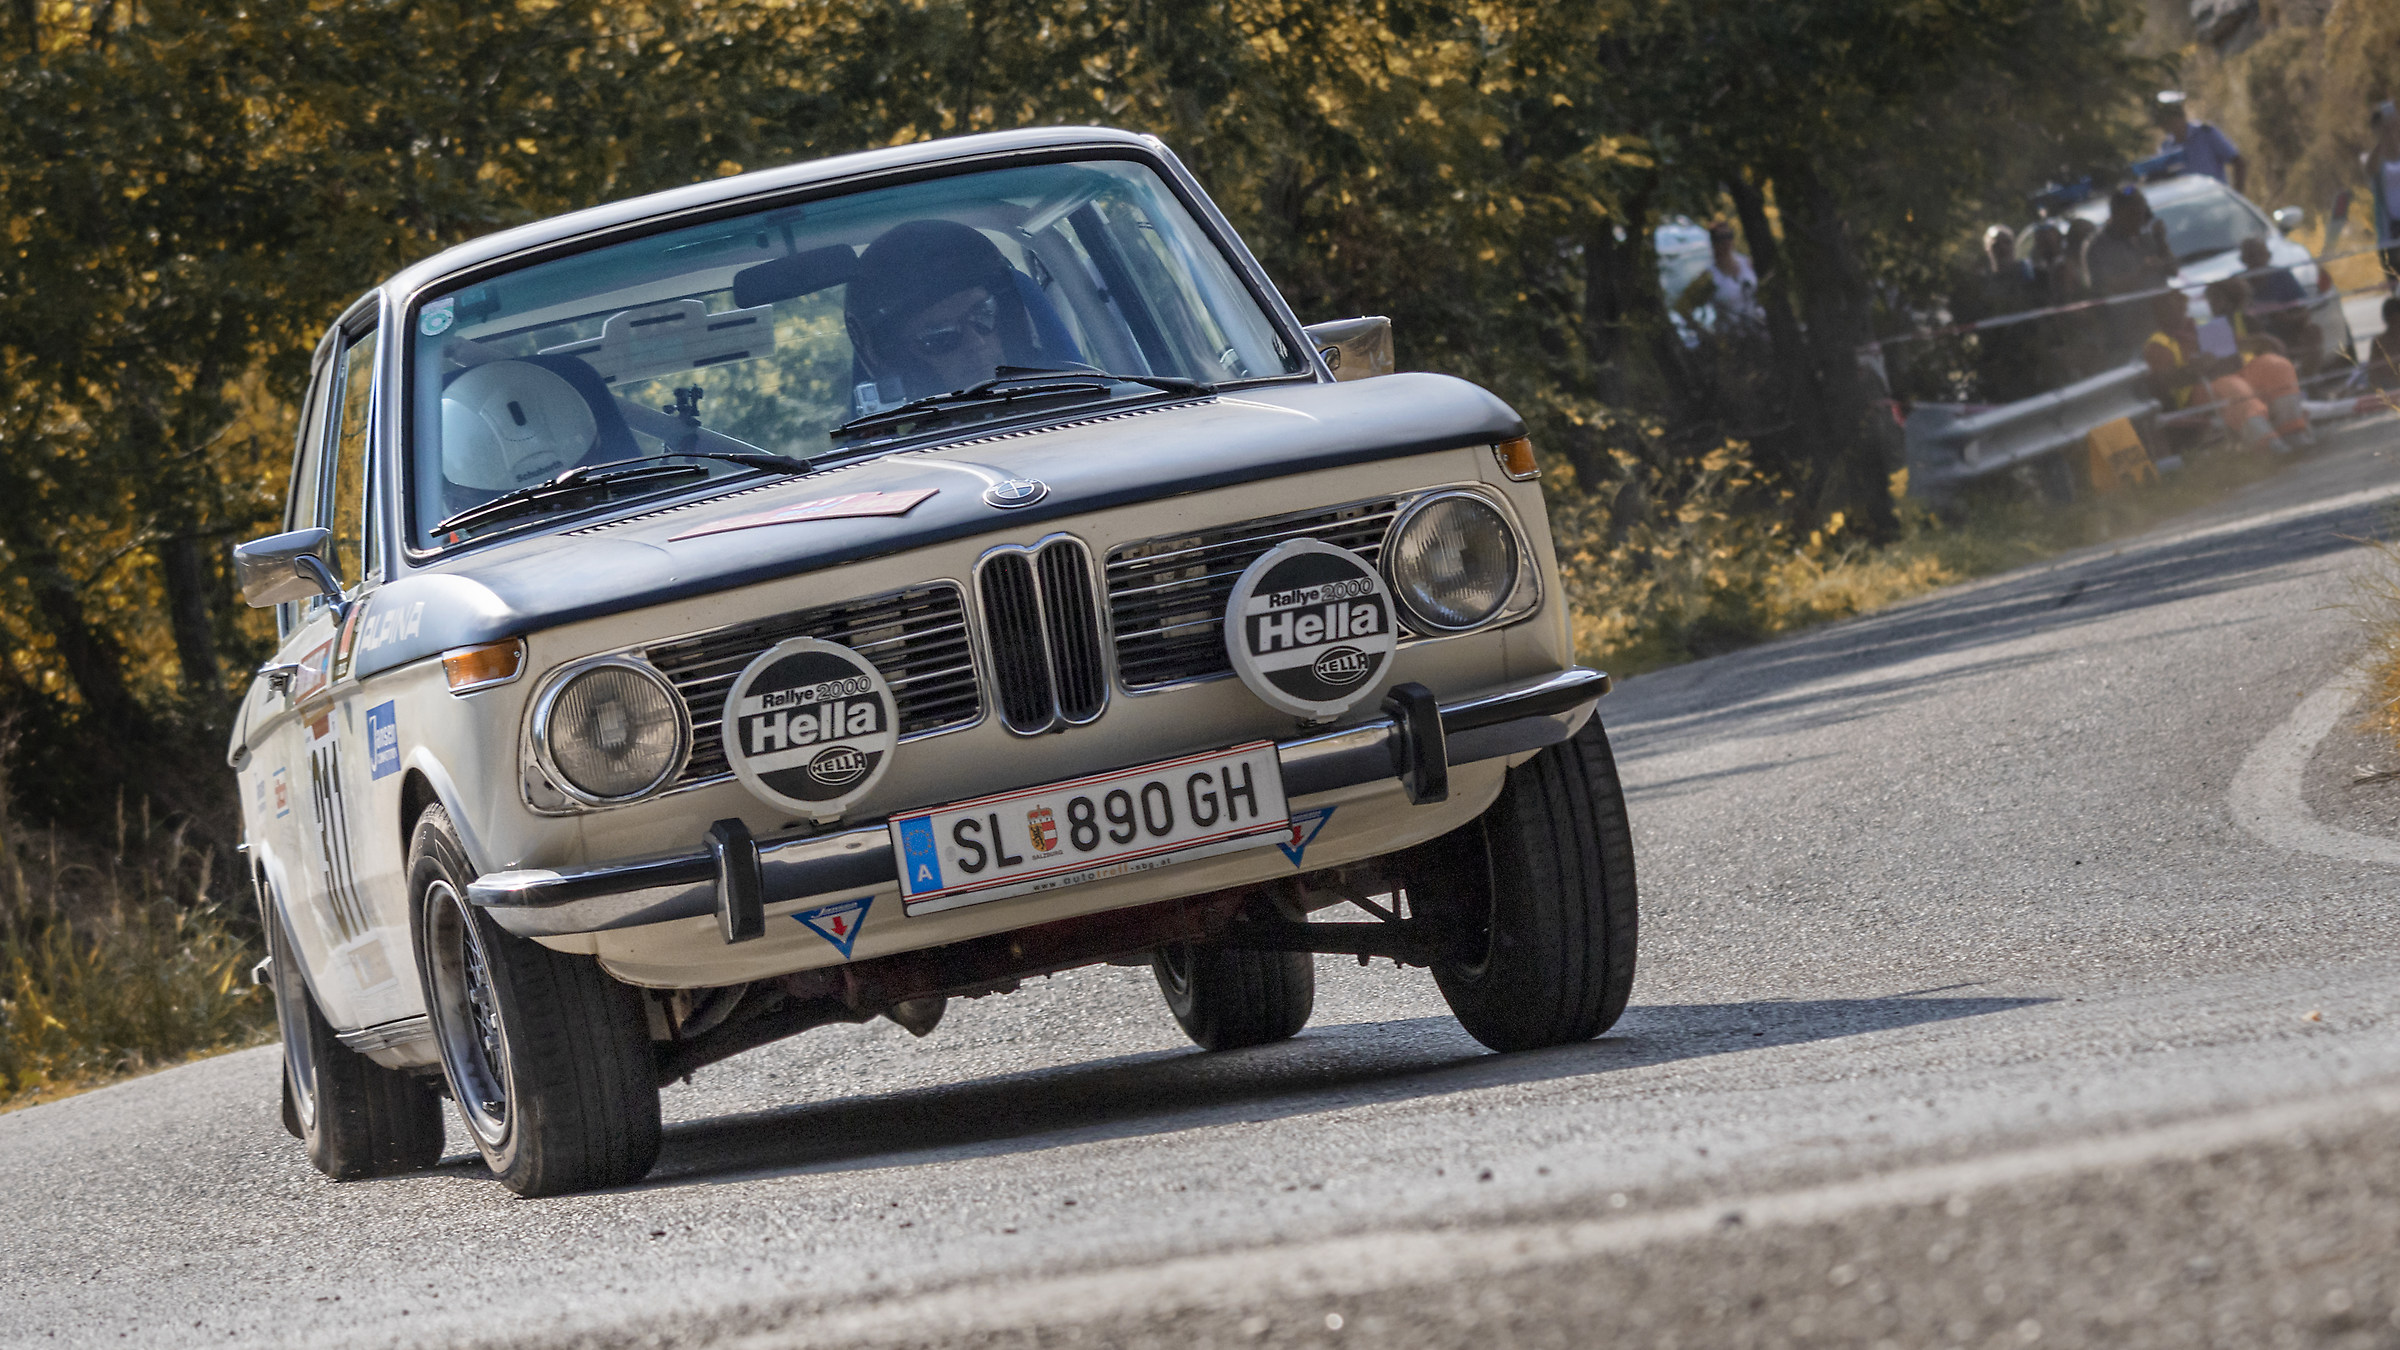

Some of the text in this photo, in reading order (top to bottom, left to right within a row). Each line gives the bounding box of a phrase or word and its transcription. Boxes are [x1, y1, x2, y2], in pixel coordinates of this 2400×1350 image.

[1269, 577, 1373, 608] Rallye 2000
[358, 602, 425, 655] ALPINA
[1259, 602, 1378, 653] Hella
[1317, 652, 1369, 674] HELLA
[762, 676, 872, 709] Rallye 2000
[752, 701, 877, 754] Hella
[811, 751, 866, 774] HELLA
[953, 762, 1259, 874] SL 890 GH
[917, 864, 933, 883] A
